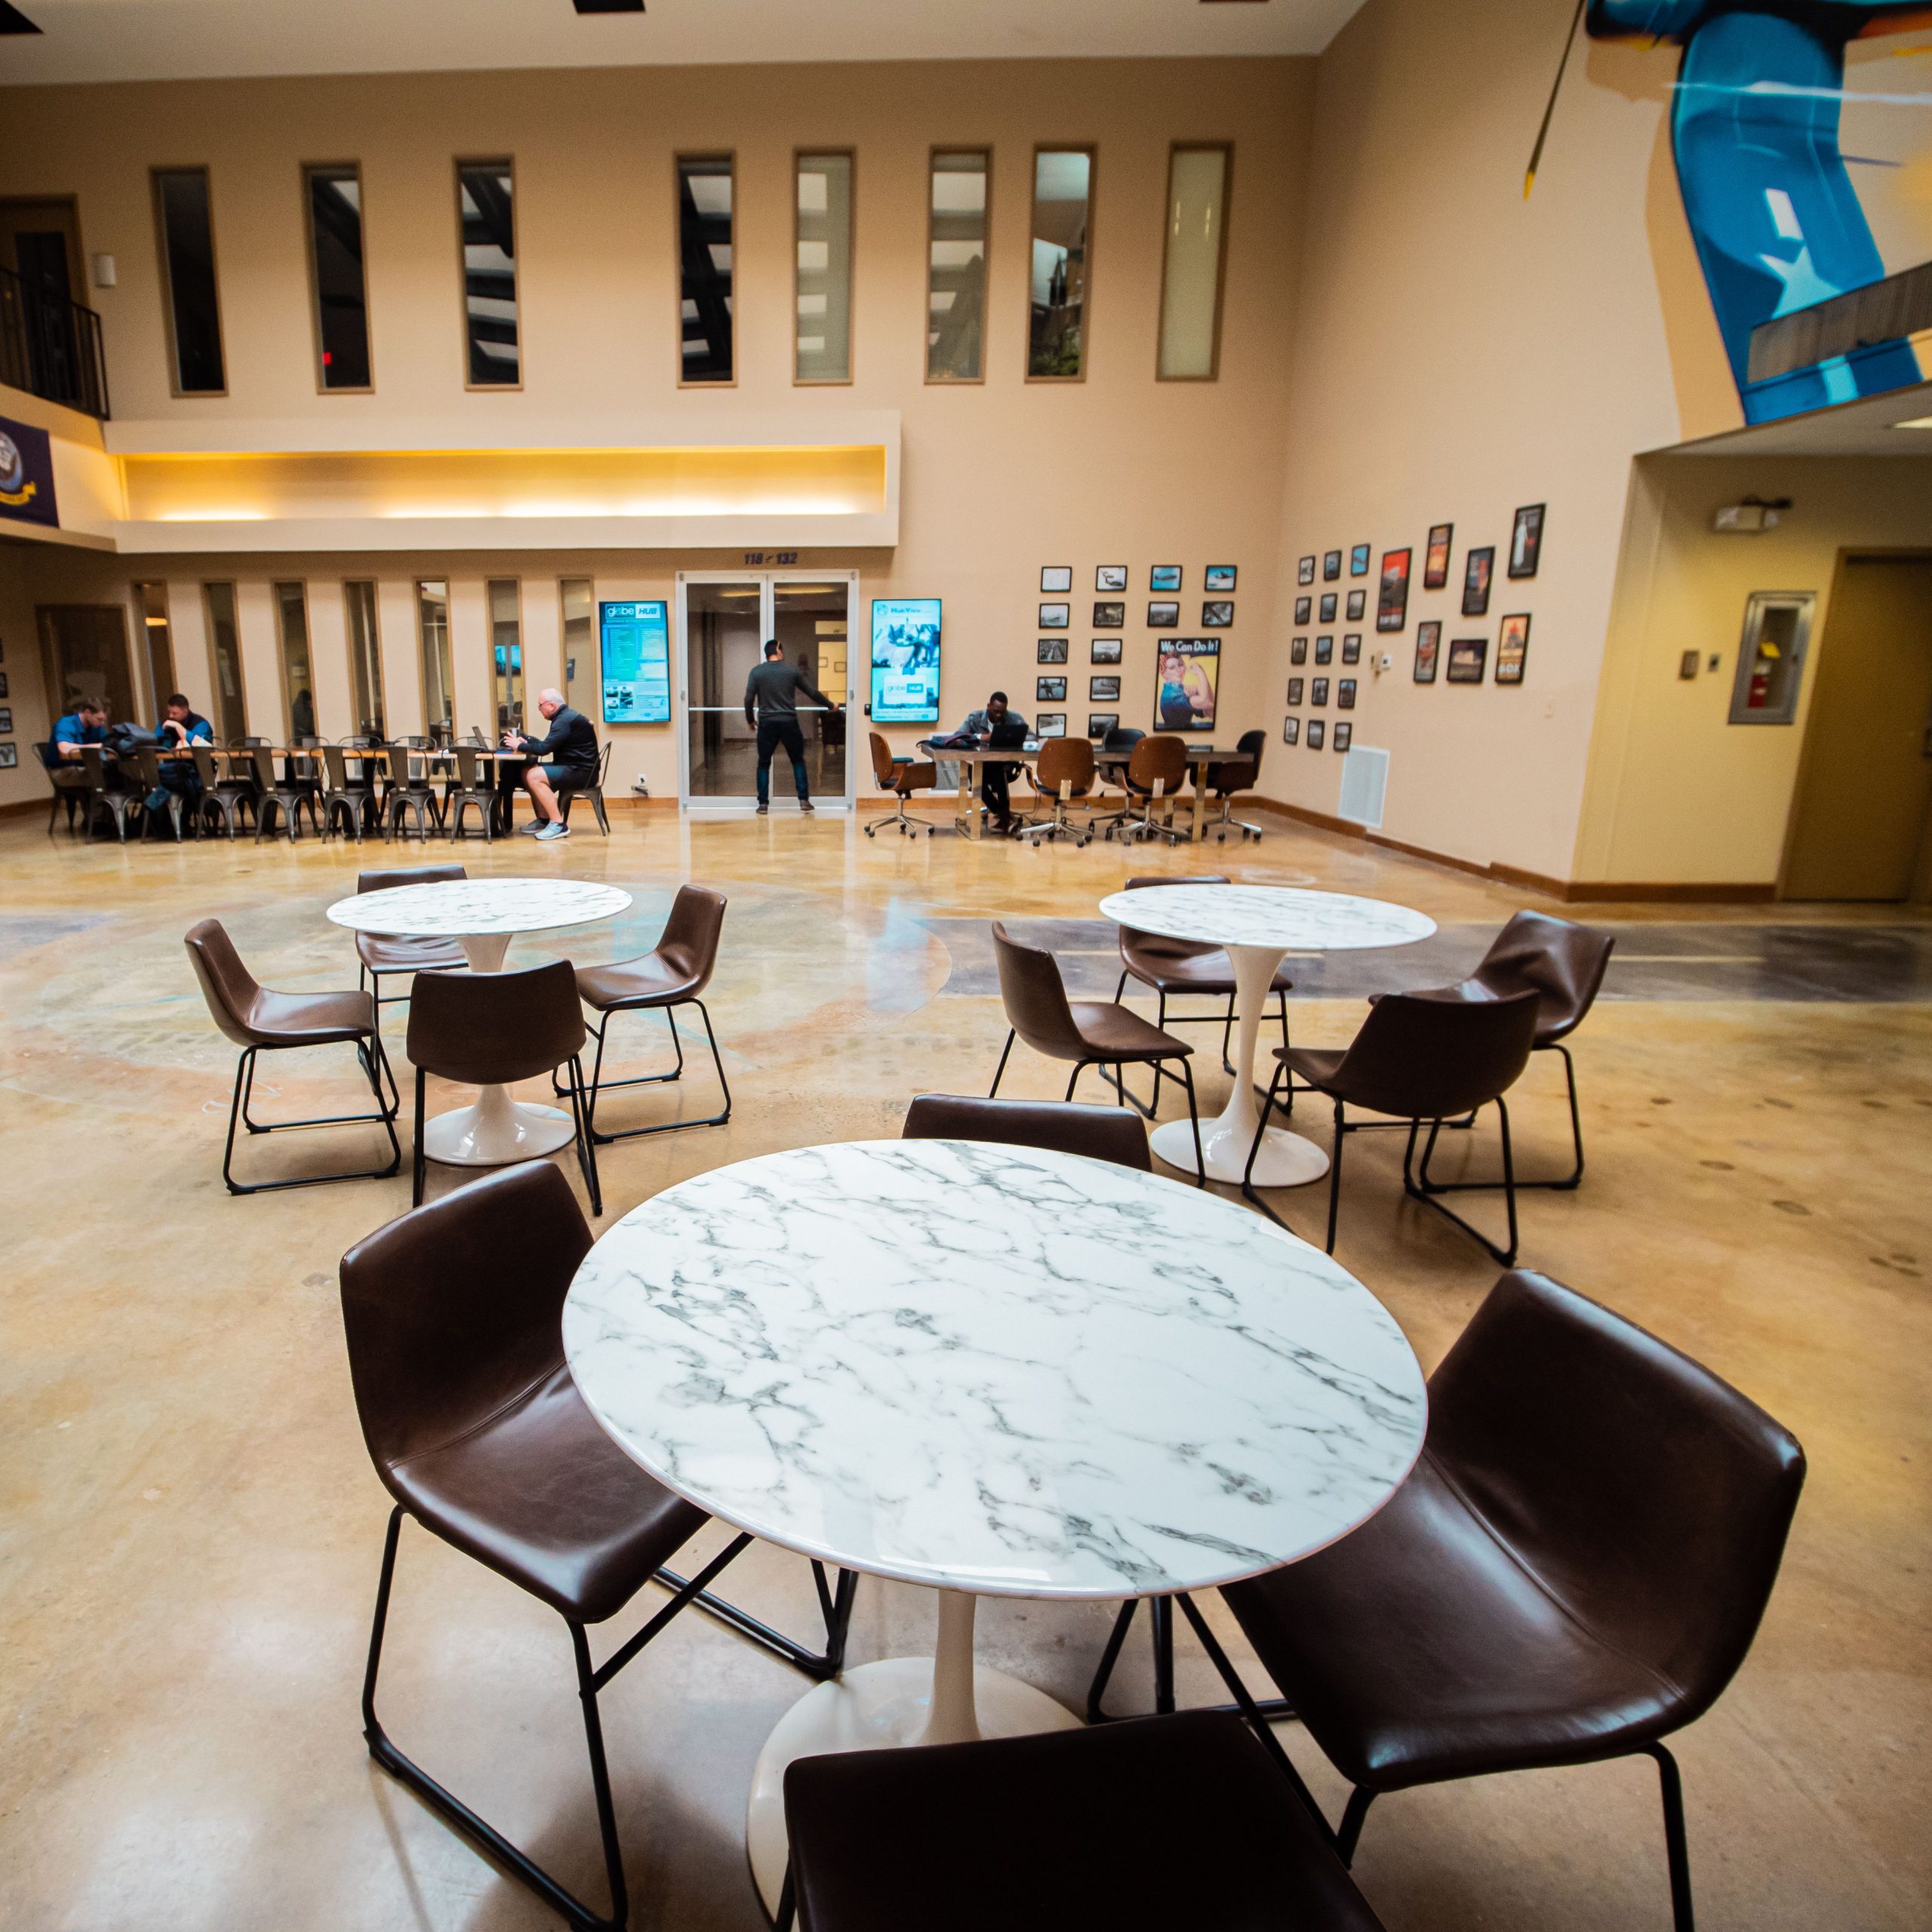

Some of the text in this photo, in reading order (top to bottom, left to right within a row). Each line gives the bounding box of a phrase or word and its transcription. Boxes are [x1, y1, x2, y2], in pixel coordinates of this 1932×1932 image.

[744, 552, 764, 565] 118
[777, 552, 798, 565] 132
[608, 606, 657, 617] globe HUB
[1161, 640, 1175, 652] We
[1176, 640, 1192, 652] Can
[1193, 640, 1207, 652] Do
